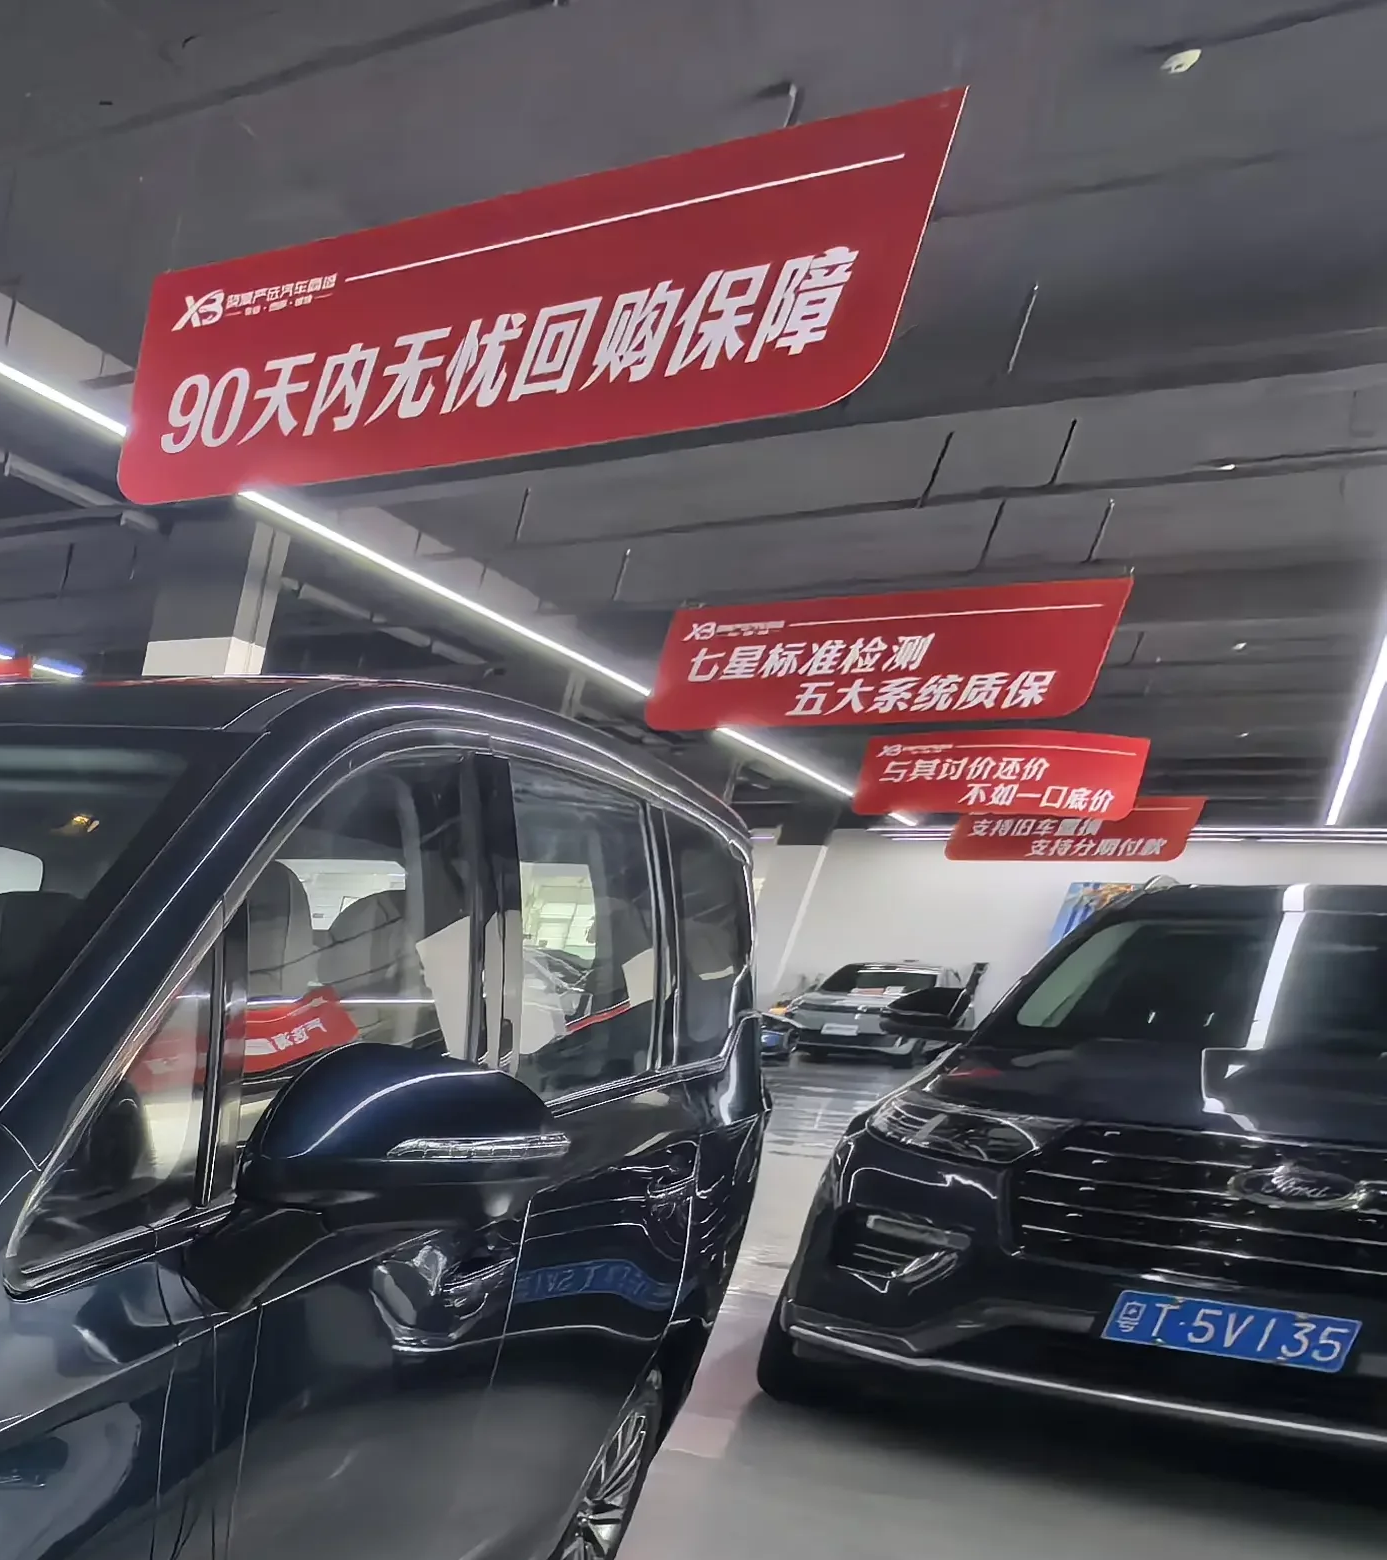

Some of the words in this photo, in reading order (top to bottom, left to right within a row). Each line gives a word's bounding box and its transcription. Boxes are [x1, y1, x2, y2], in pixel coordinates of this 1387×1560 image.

[160, 245, 859, 455] 90天内无忧回购保障
[687, 632, 936, 682] 七星标准检测
[785, 670, 1057, 717] 五大系统质保
[879, 757, 1050, 783] 与其讨价还价
[958, 783, 1115, 813] 不如一口底价
[968, 818, 1103, 838] 支持旧车置换
[1025, 838, 1167, 858] 支持分期付款
